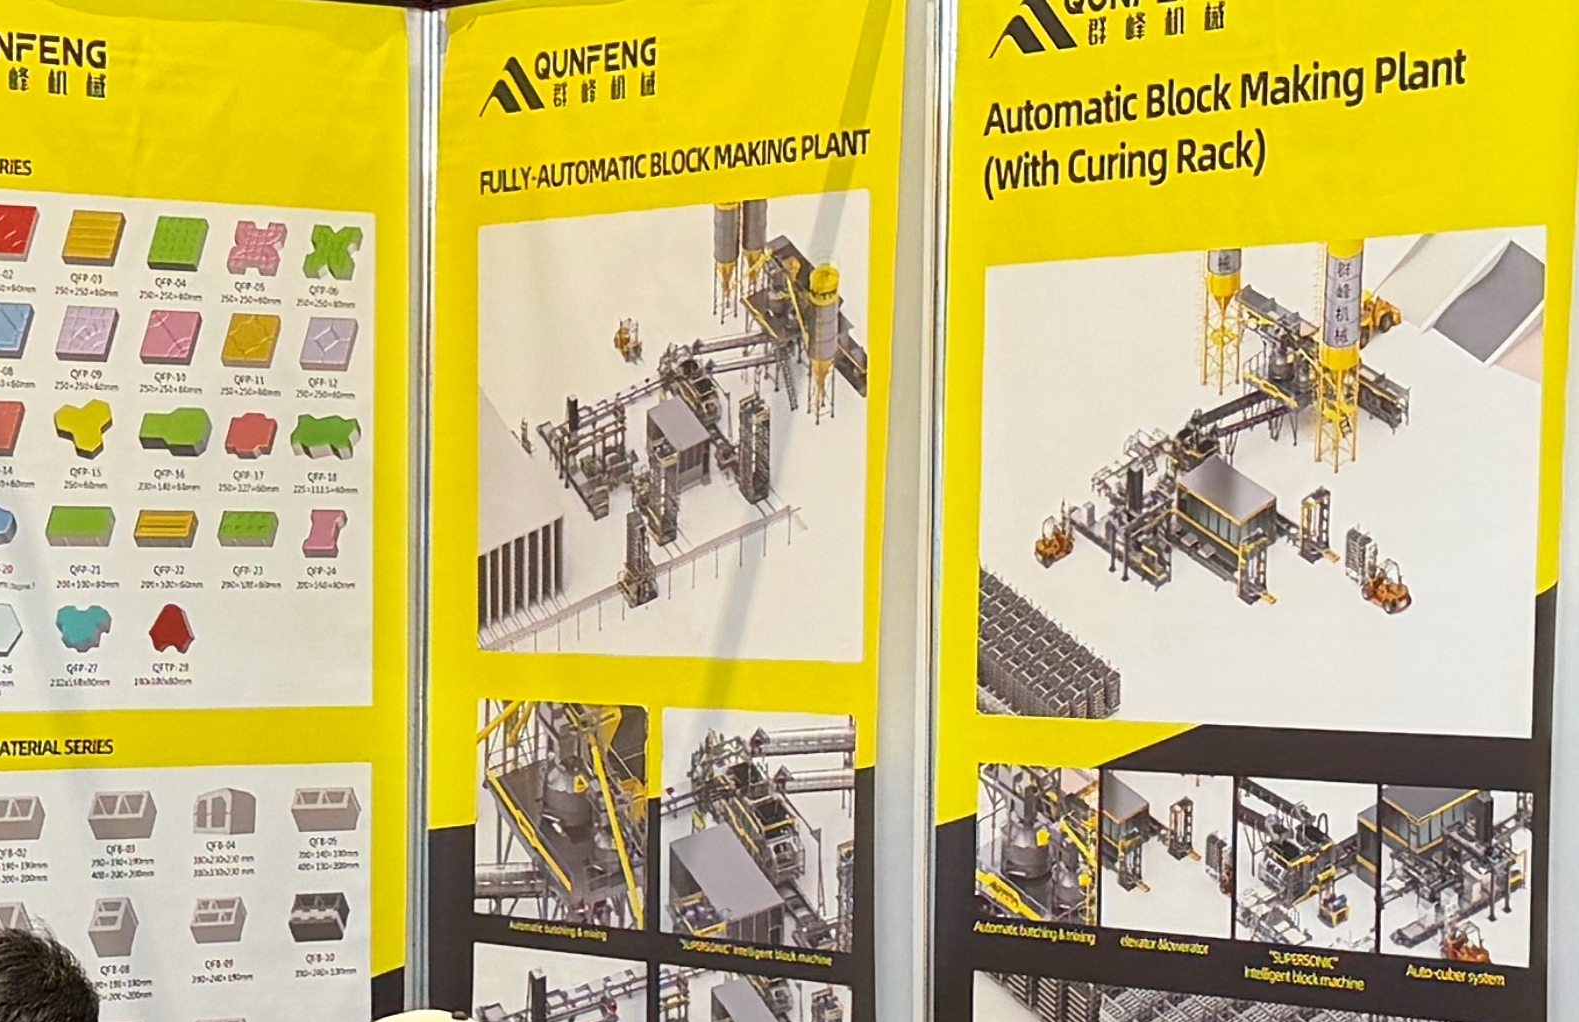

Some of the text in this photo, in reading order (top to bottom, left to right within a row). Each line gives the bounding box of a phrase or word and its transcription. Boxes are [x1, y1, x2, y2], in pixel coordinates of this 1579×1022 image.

[534, 36, 657, 80] QUNFENG
[983, 48, 1467, 136] Automatic Block Making Plant
[480, 128, 871, 195] FULLY-AUTOMATIC BLOCK MAKING PLANT
[983, 128, 1267, 201] (With Curing Rack)
[63, 739, 114, 756] SERIES
